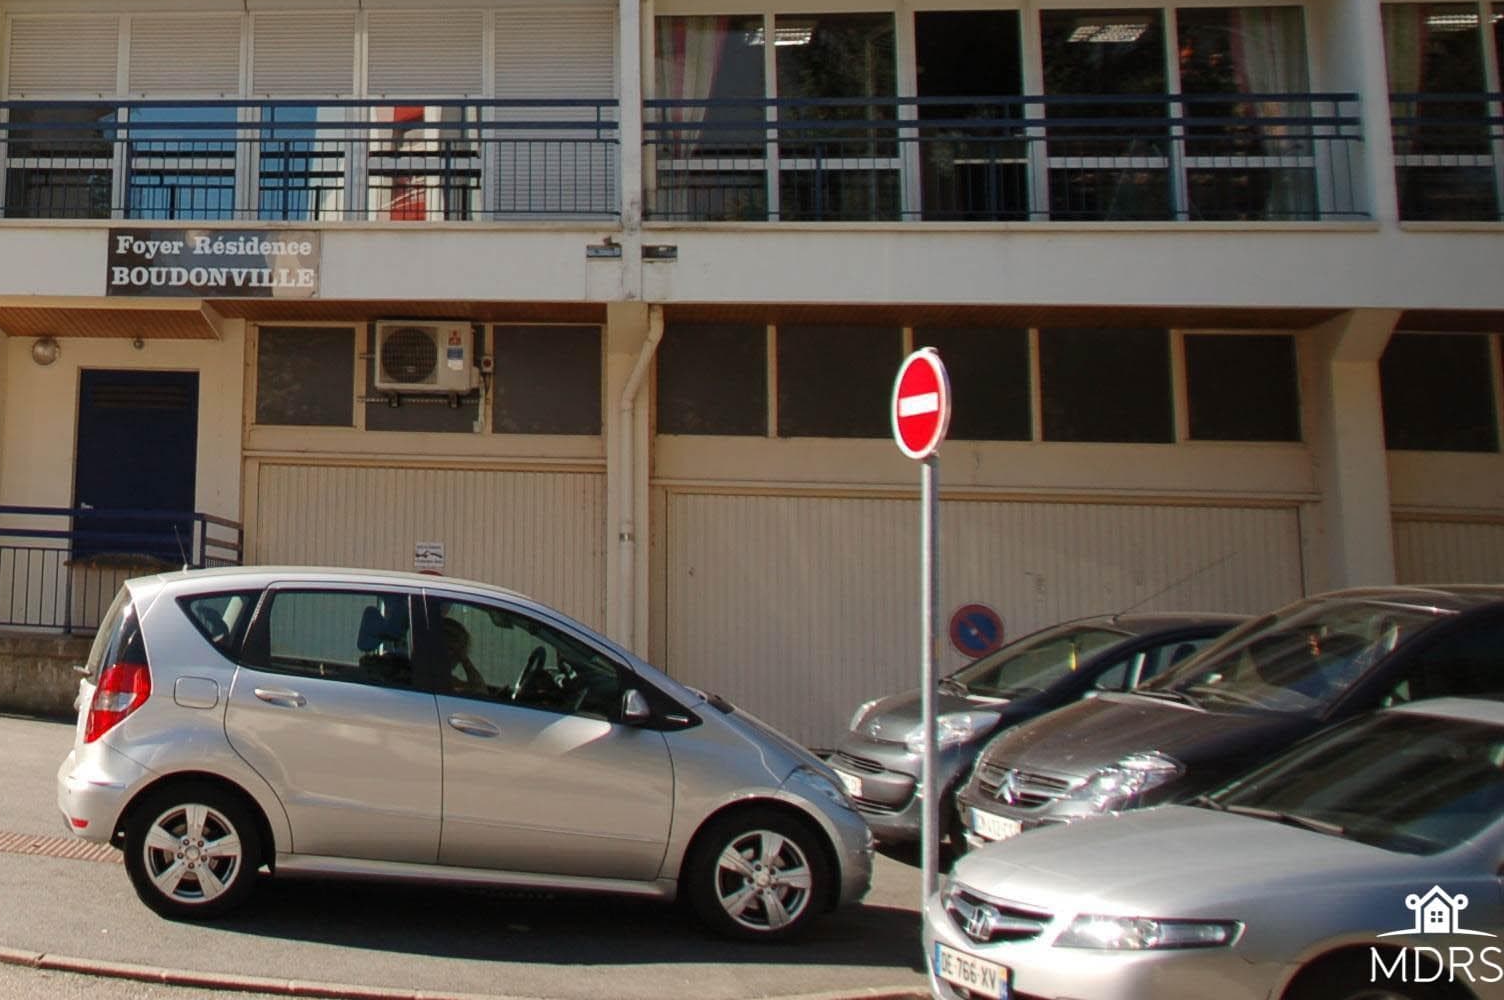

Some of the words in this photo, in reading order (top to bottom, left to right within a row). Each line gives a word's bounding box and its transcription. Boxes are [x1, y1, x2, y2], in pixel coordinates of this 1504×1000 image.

[116, 235, 184, 259] Foyer
[193, 235, 312, 255] Résidence
[111, 266, 314, 288] BOUDONVILLE
